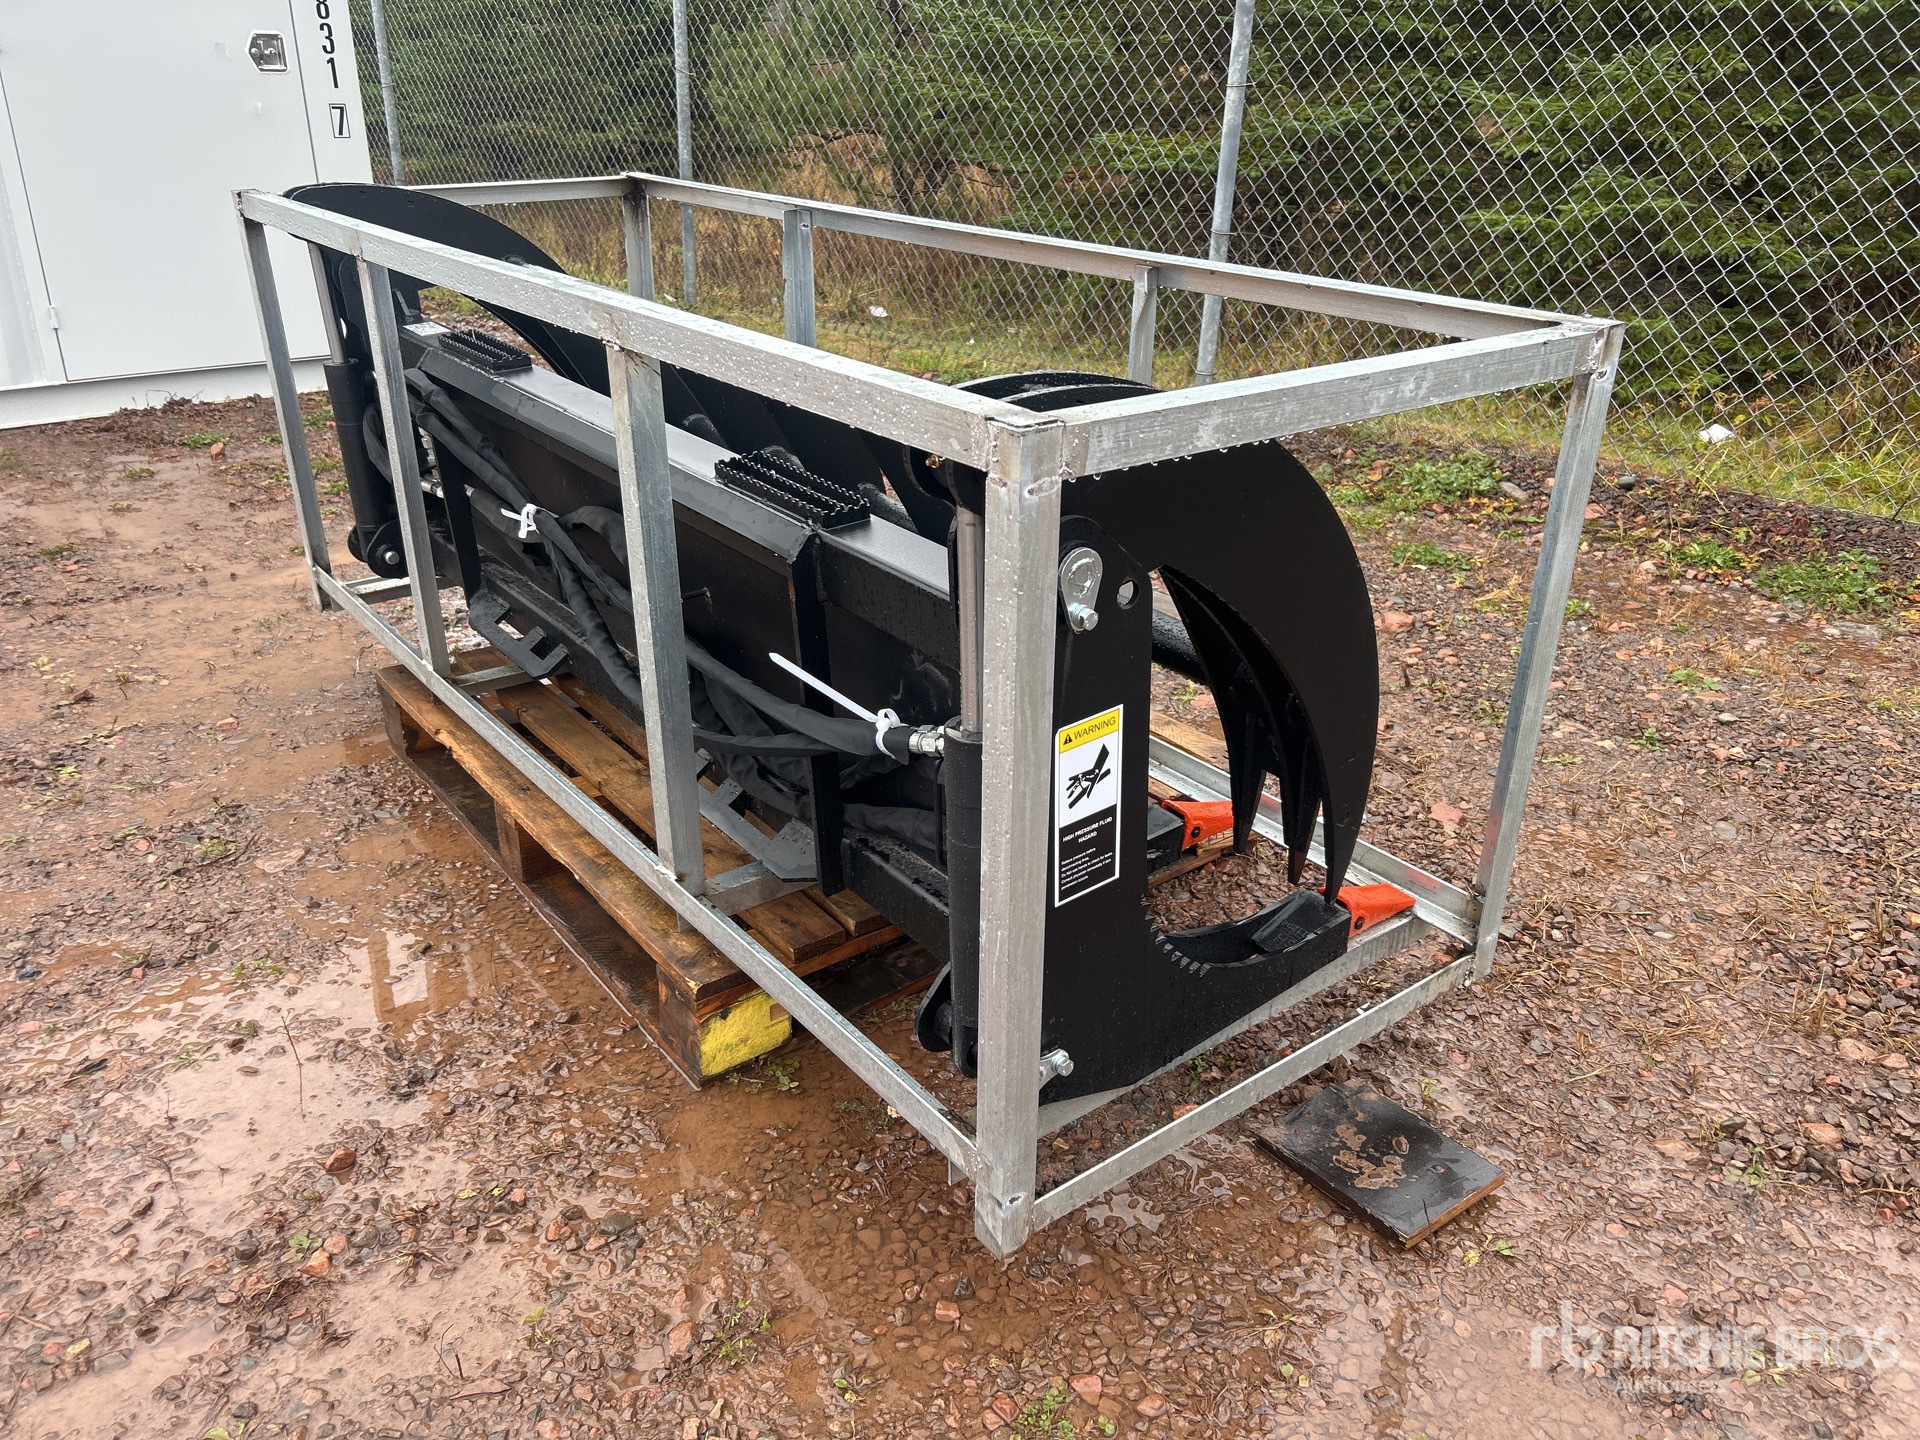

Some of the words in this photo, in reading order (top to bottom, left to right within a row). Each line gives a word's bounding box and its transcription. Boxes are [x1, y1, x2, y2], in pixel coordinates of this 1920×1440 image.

[331, 106, 345, 136] 7
[1073, 716, 1116, 741] WARNING
[1062, 833, 1075, 843] HIGH
[1074, 822, 1099, 837] PRESSURE
[1099, 816, 1113, 826] FLUID
[1078, 831, 1098, 843] HAZARD
